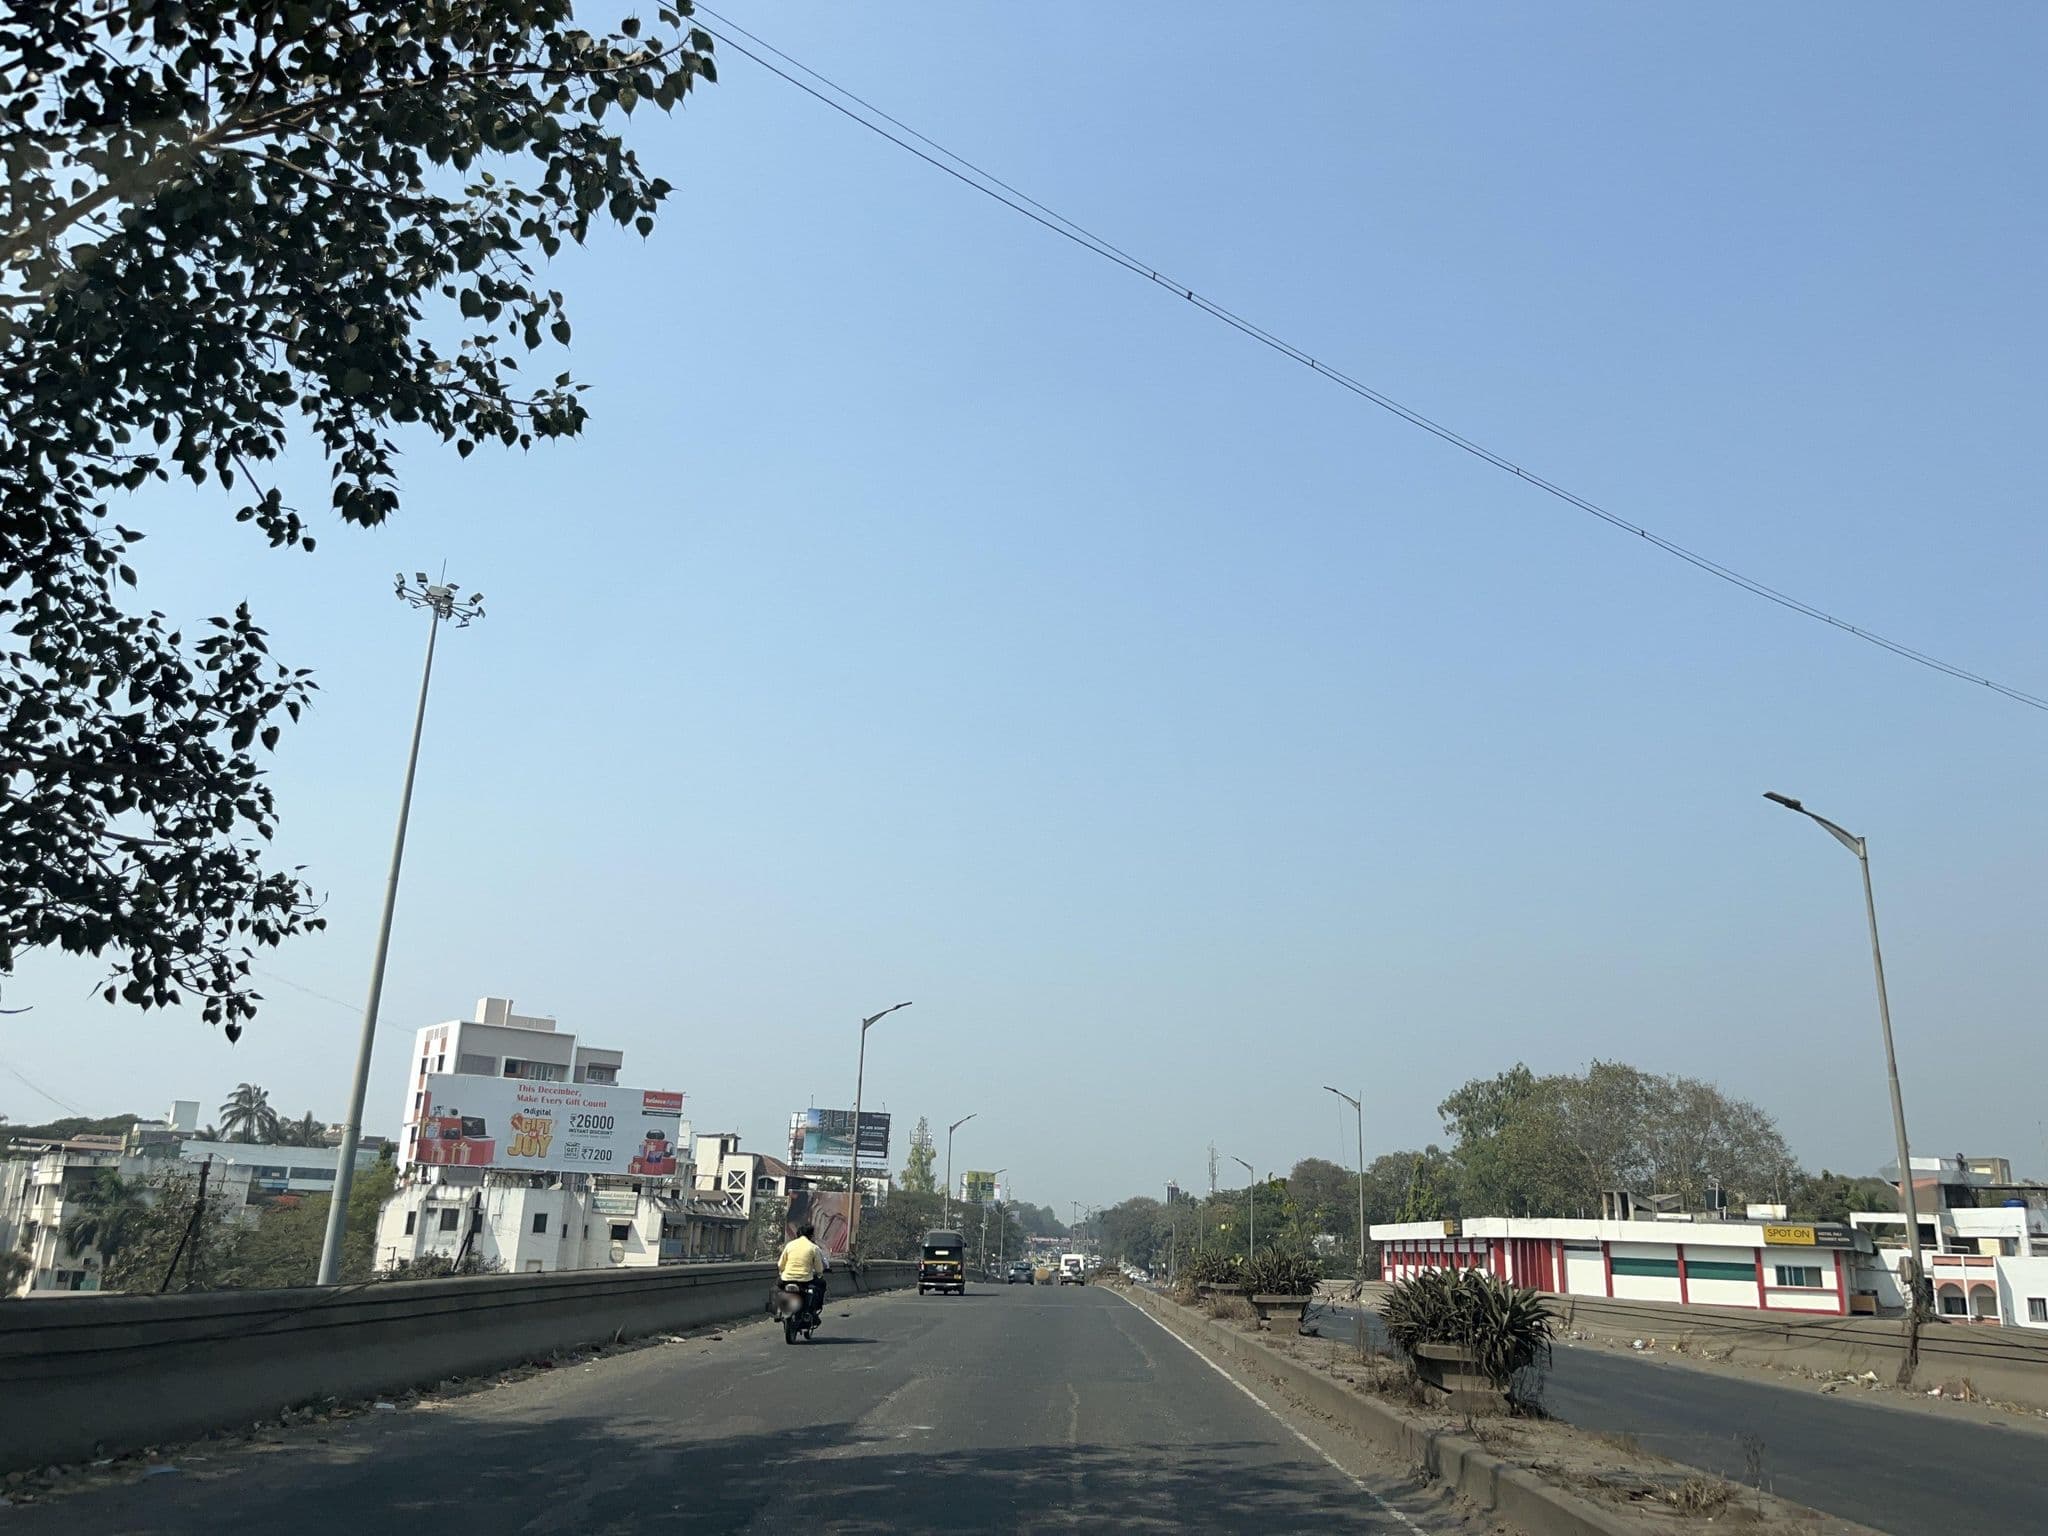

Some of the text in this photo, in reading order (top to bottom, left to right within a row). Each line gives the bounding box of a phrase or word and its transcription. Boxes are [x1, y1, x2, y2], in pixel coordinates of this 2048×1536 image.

[519, 1084, 582, 1097] This December,
[517, 1094, 607, 1108] Make Every Gift Count
[529, 1108, 552, 1117] digital
[521, 1118, 552, 1134] GIFT
[507, 1133, 553, 1158] JOY
[1767, 1228, 1810, 1238] SPOT ON
